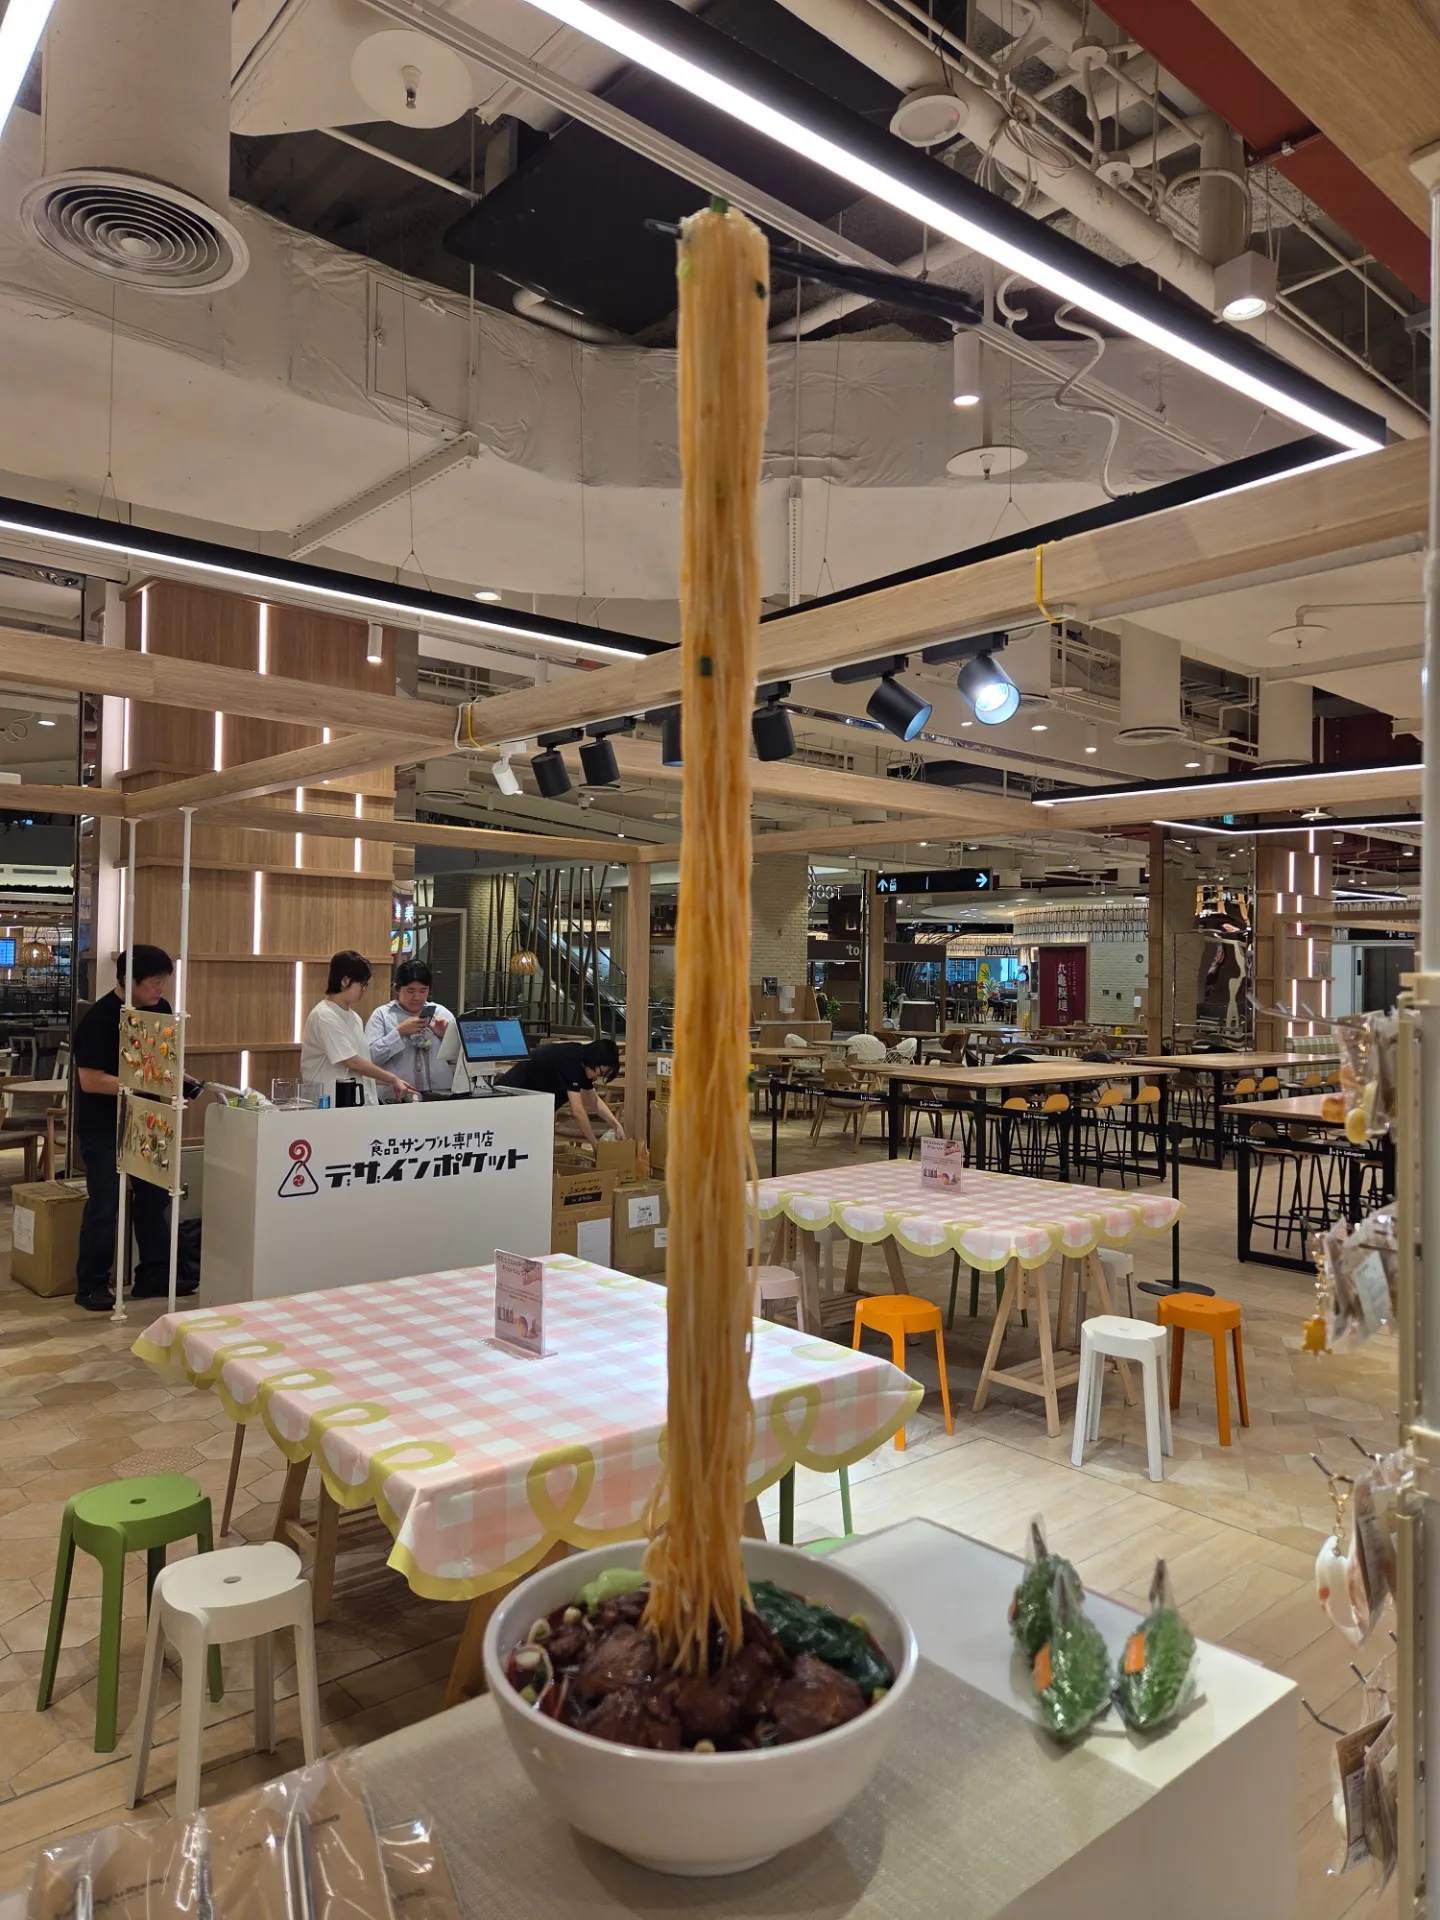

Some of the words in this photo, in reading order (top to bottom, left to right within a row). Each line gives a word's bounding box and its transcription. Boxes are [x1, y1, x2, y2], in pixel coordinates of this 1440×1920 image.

[369, 1130, 494, 1157] 食品サンプル専門店
[325, 1149, 528, 1188] デザインポケット
